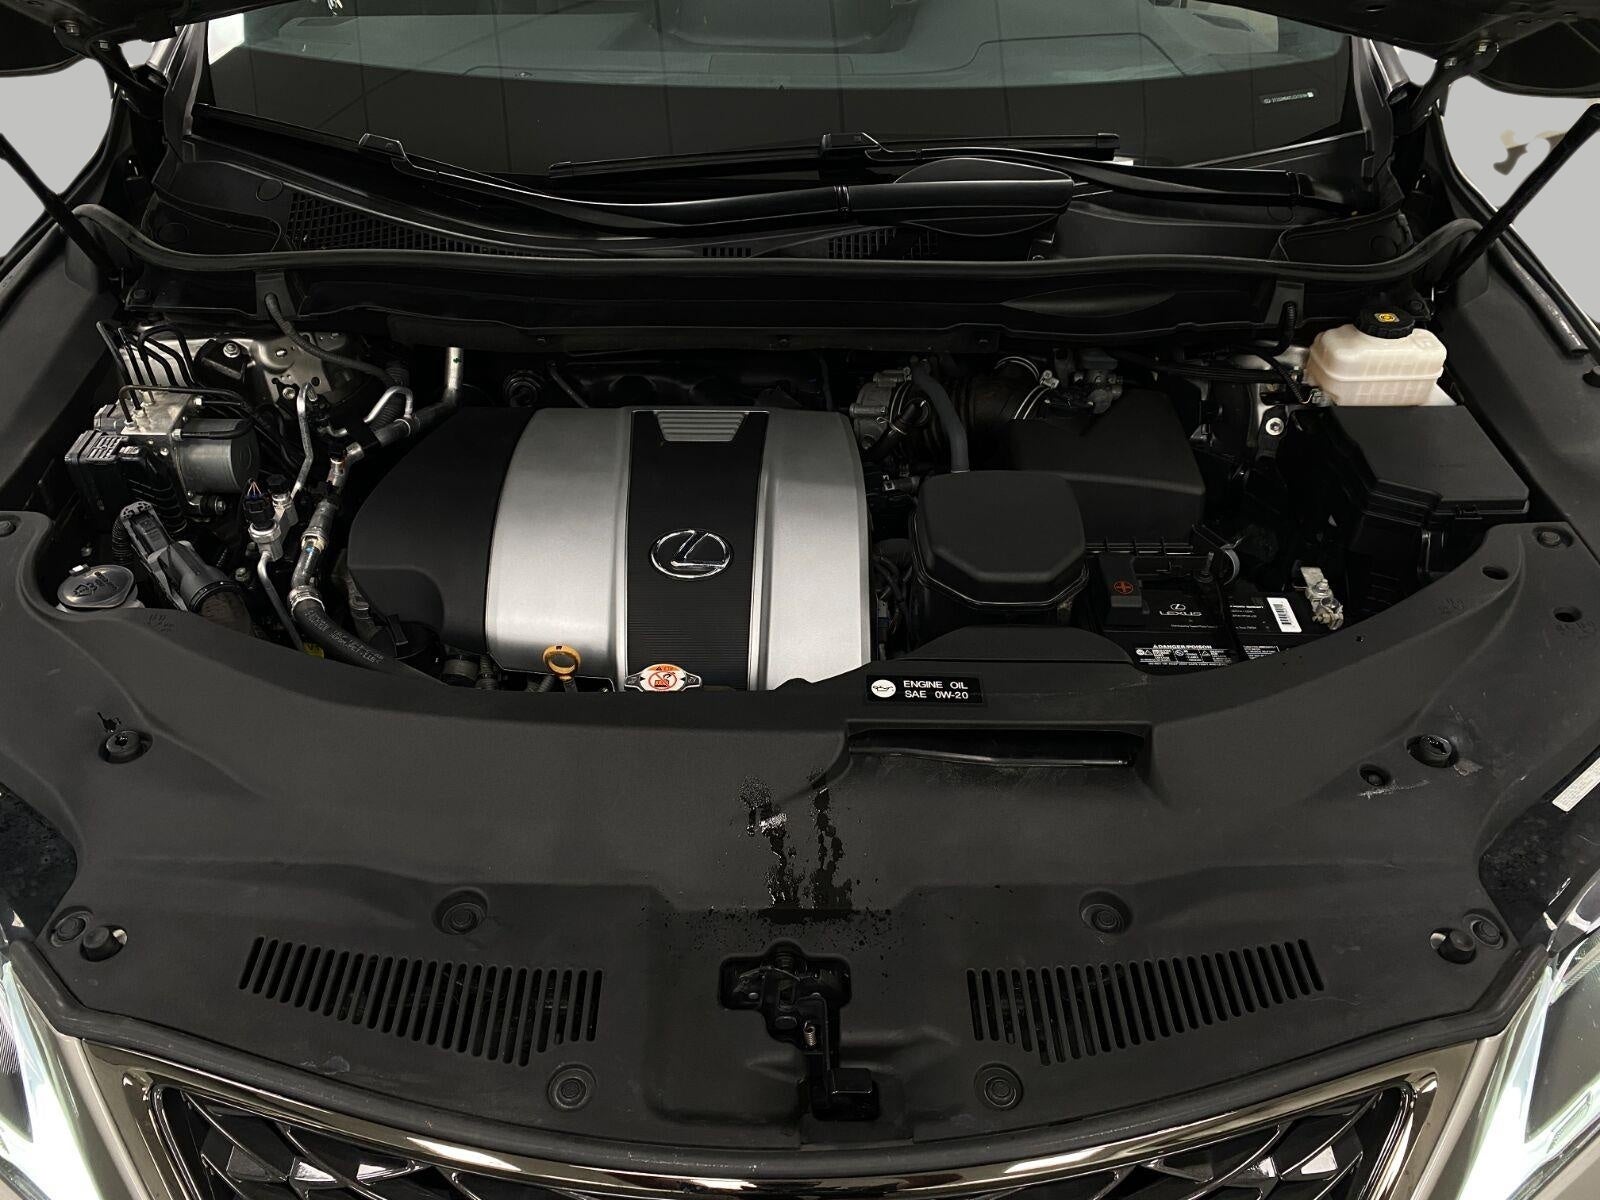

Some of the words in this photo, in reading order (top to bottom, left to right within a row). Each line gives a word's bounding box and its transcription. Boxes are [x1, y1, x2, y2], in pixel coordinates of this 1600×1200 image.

[903, 680, 944, 689] ENGINE
[949, 681, 968, 690] OIL
[904, 690, 927, 699] SAE
[934, 691, 969, 699] 0W-20
